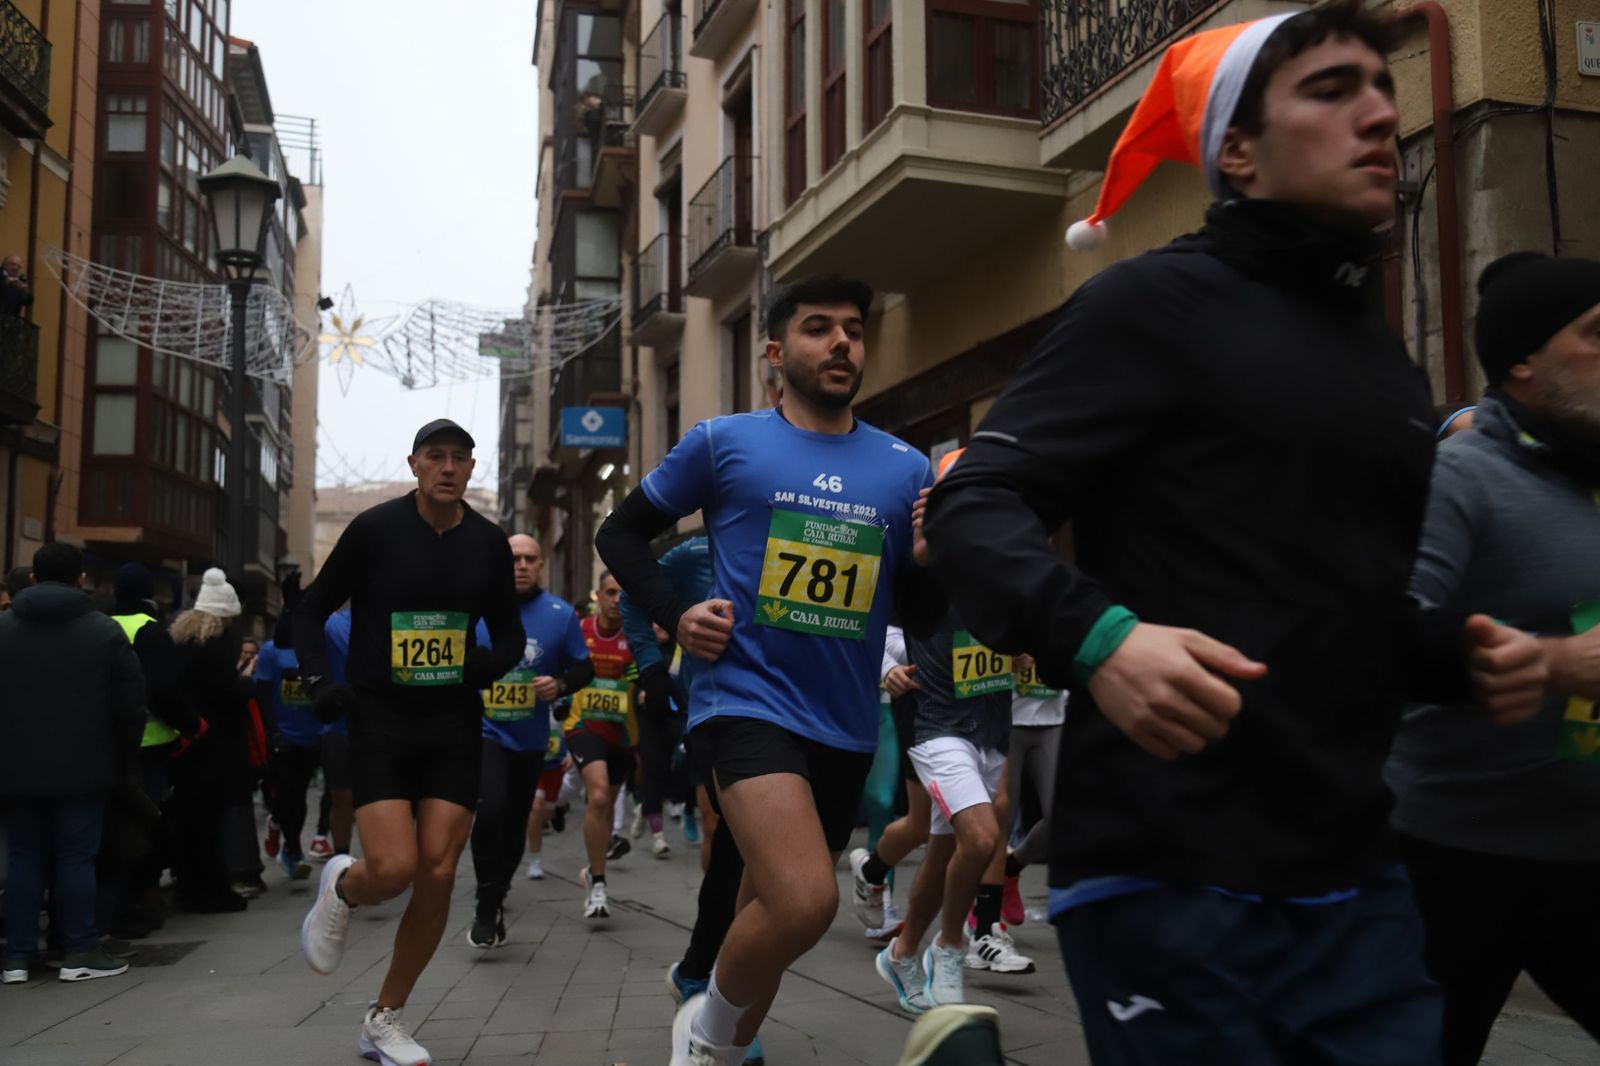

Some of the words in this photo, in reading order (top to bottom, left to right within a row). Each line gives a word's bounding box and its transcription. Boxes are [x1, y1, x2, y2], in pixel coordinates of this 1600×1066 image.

[813, 473, 843, 493] 46
[774, 491, 796, 503] SAN
[798, 494, 850, 513] SILVESTRE
[853, 504, 877, 517] 2025
[803, 528, 825, 539] CAJA
[827, 533, 857, 545] RURAL
[778, 552, 859, 608] 781
[789, 610, 821, 626] CAJA
[823, 615, 861, 631] RURAL
[398, 637, 454, 667] 1264
[957, 651, 1003, 680] 706
[414, 672, 435, 680] CAJA
[489, 685, 528, 705] 1243
[586, 692, 620, 712] 1269
